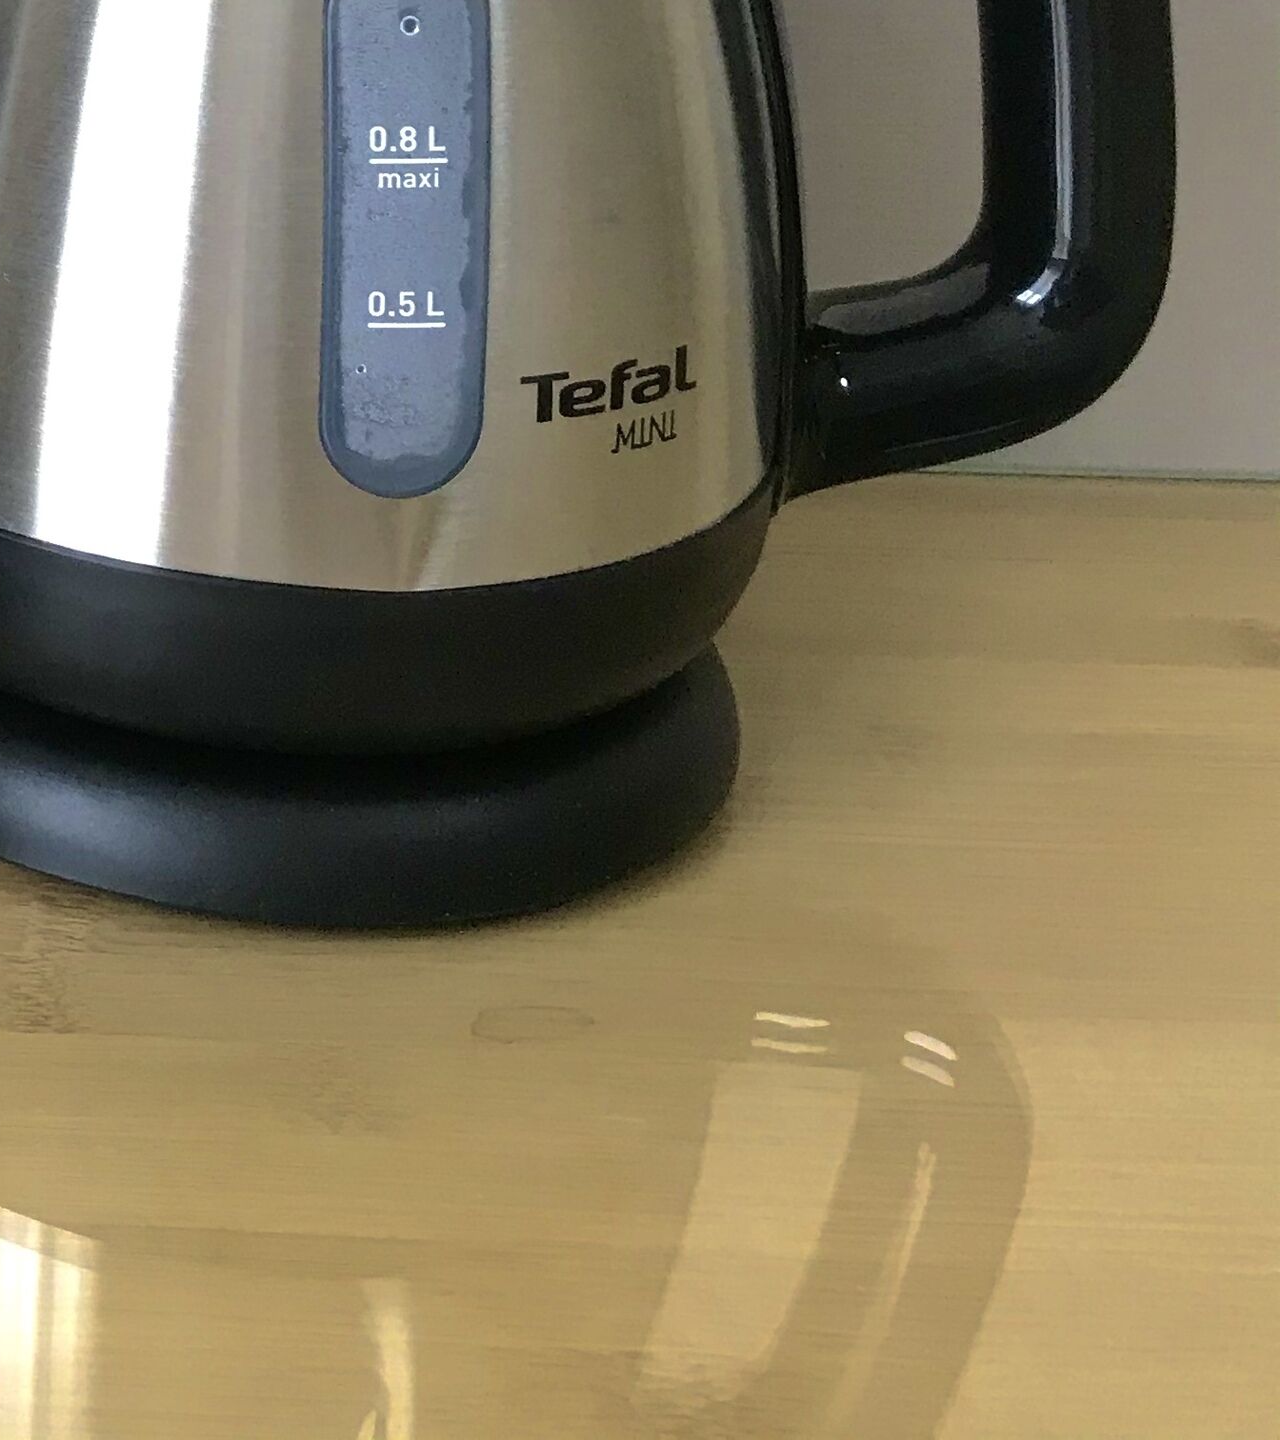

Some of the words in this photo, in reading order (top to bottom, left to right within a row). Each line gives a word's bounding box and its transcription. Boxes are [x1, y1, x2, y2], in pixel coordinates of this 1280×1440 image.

[368, 126, 417, 152] 0.8
[428, 126, 446, 152] L
[377, 167, 440, 189] maxi
[367, 291, 416, 317] 0.5
[426, 291, 445, 316] L
[520, 344, 697, 423] Tefal
[610, 410, 677, 454] MINI
